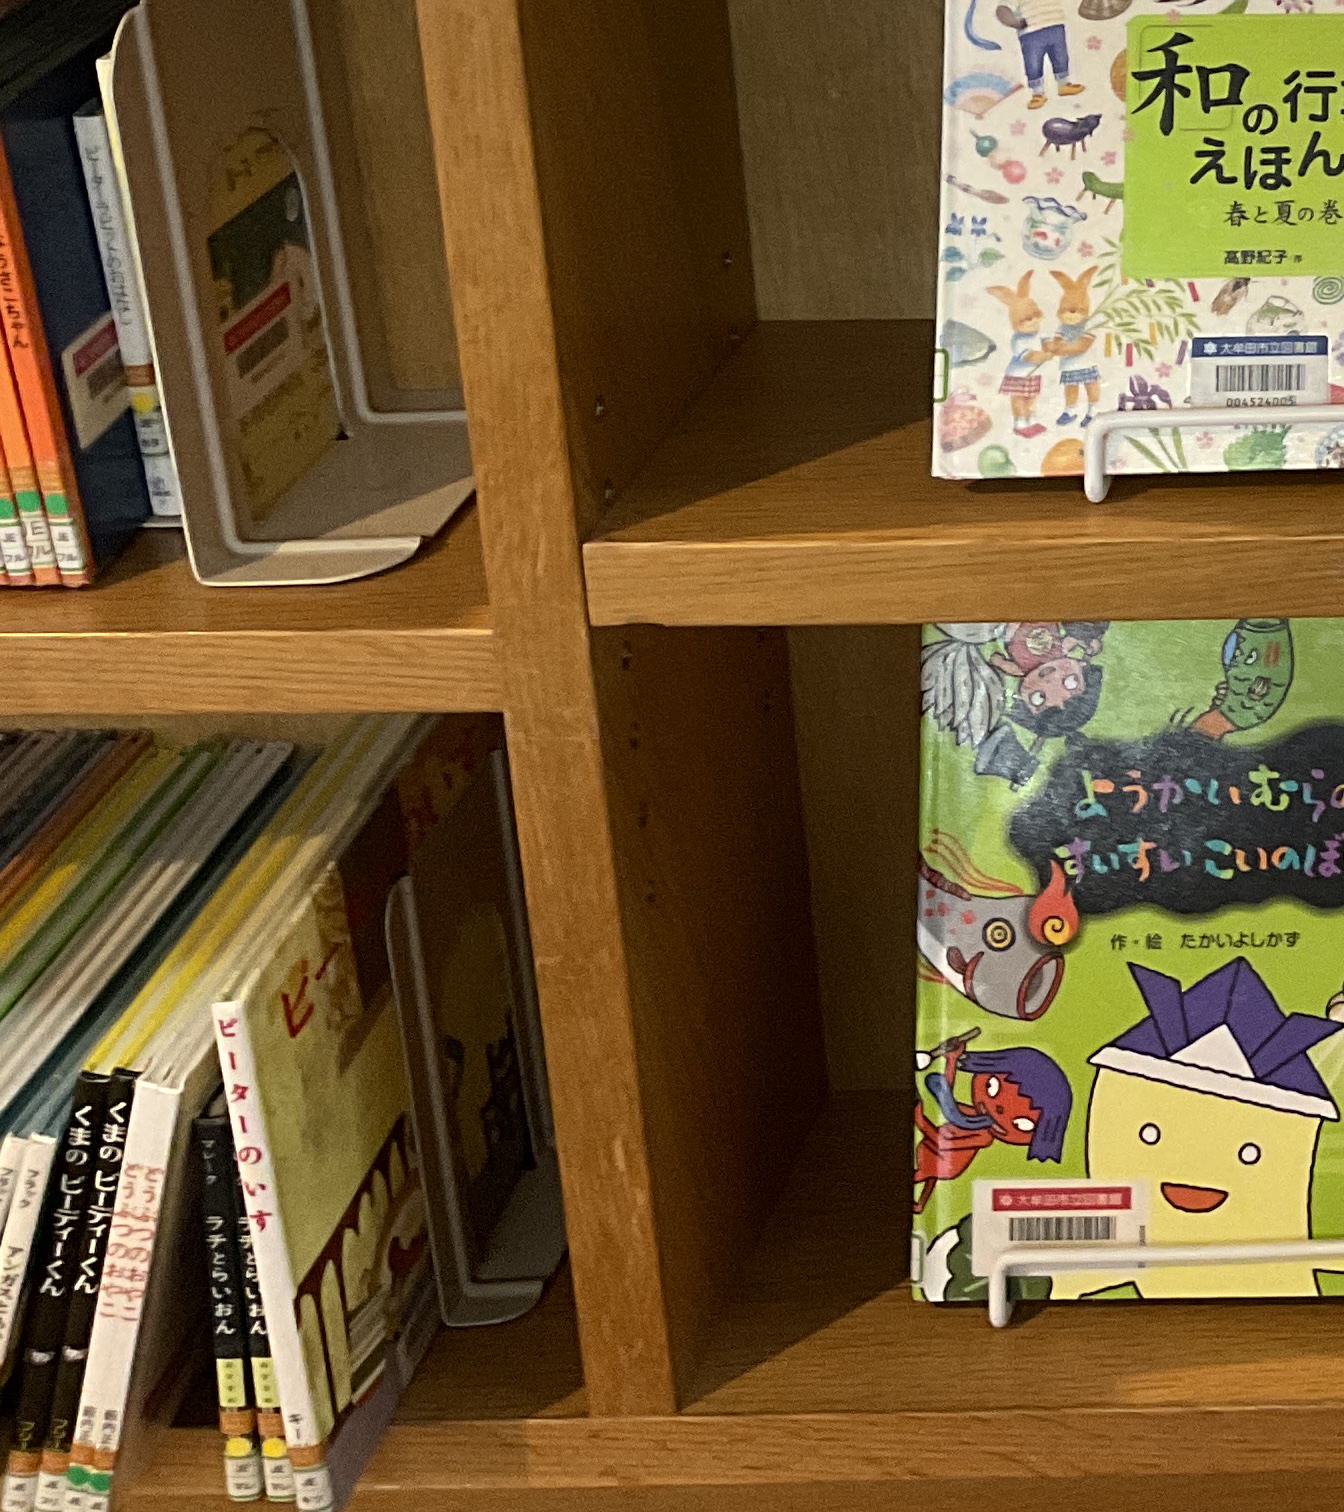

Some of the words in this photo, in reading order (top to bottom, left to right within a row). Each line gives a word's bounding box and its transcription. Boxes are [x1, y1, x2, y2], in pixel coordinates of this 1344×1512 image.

[1222, 199, 1344, 228] 春と夏の巻
[1179, 931, 1300, 950] たかいよしかず
[64, 1105, 93, 1166] くまの
[98, 1101, 127, 1163] くまの
[217, 1017, 274, 1233] ピーターのいす
[39, 1173, 86, 1297] ビーディーくん
[73, 1169, 119, 1294] ビーディーくん
[204, 1215, 236, 1336] ラチとらいおん
